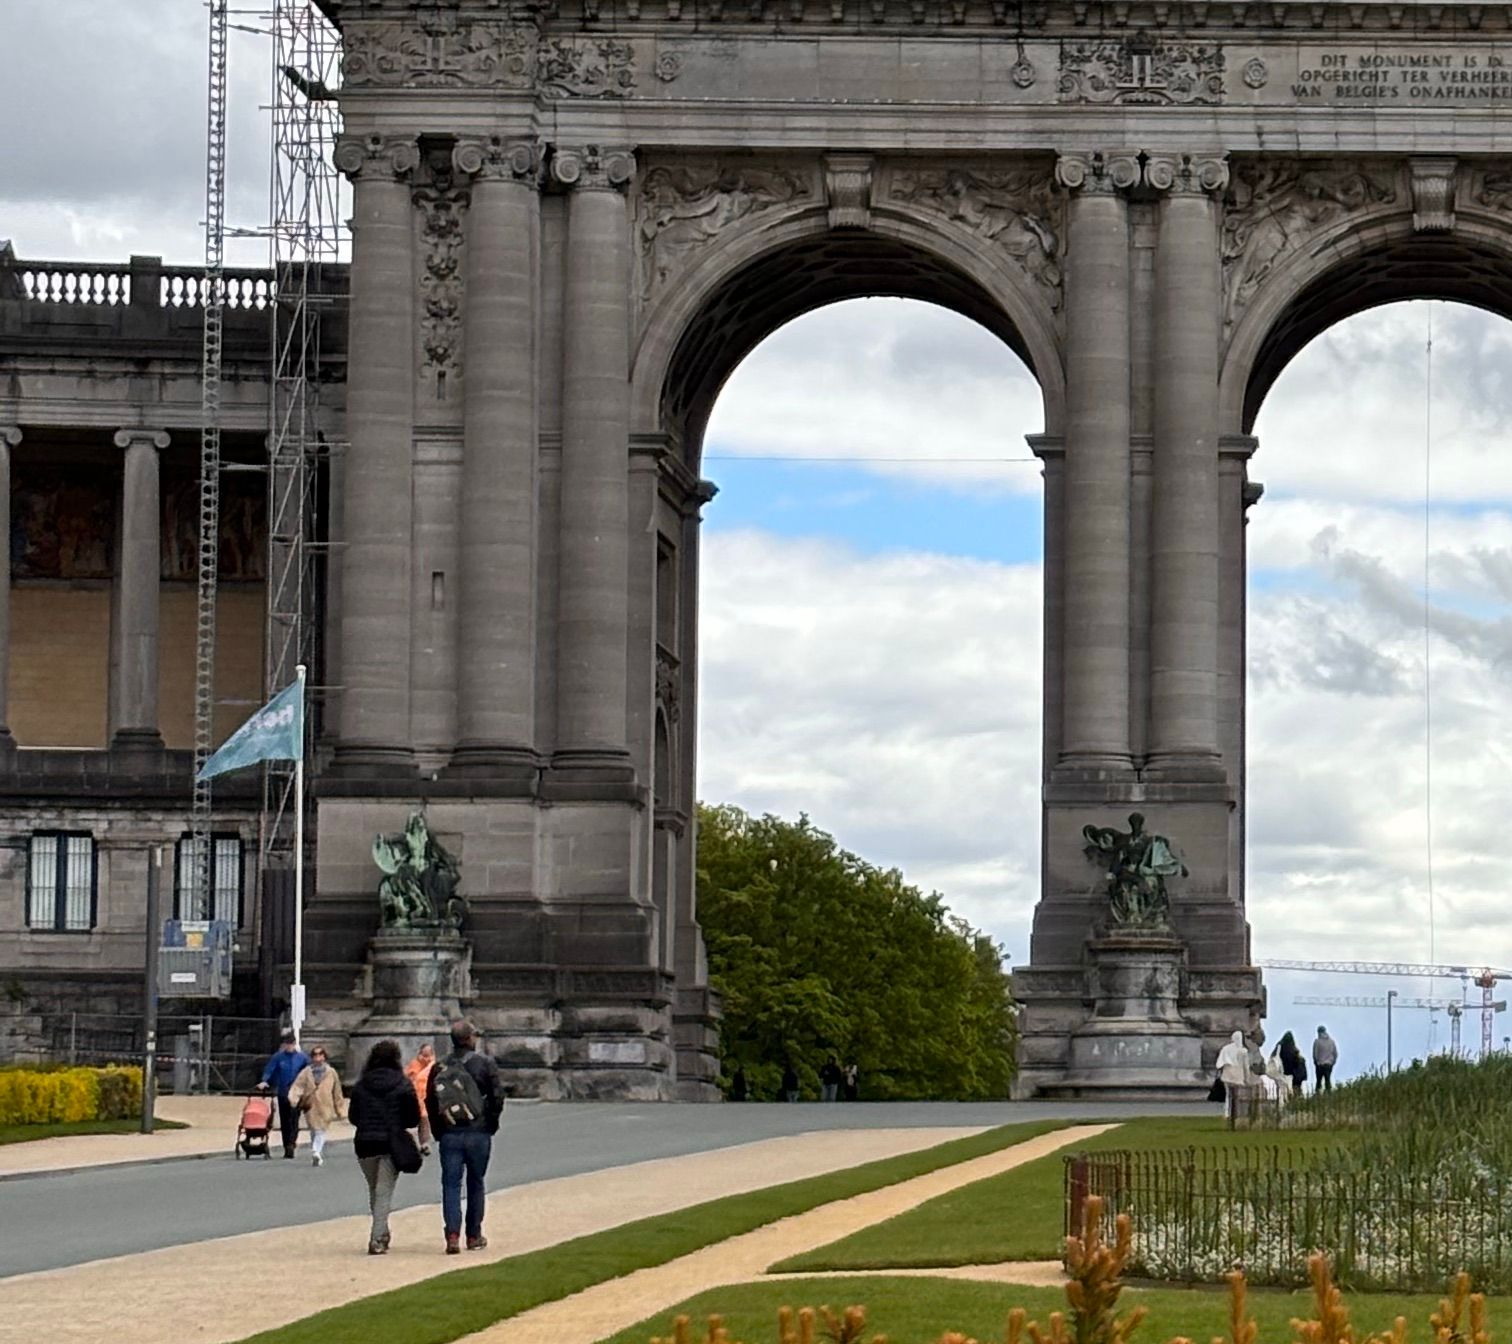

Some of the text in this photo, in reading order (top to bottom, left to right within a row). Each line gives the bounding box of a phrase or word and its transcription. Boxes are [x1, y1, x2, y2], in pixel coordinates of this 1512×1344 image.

[1320, 54, 1348, 67] DIT
[1358, 54, 1452, 68] MONUMENT
[1464, 55, 1478, 68] IS
[1487, 55, 1501, 68] IN
[1300, 69, 1389, 83] OPGERICHT
[1400, 70, 1430, 83] TER
[1291, 84, 1322, 97] VAN
